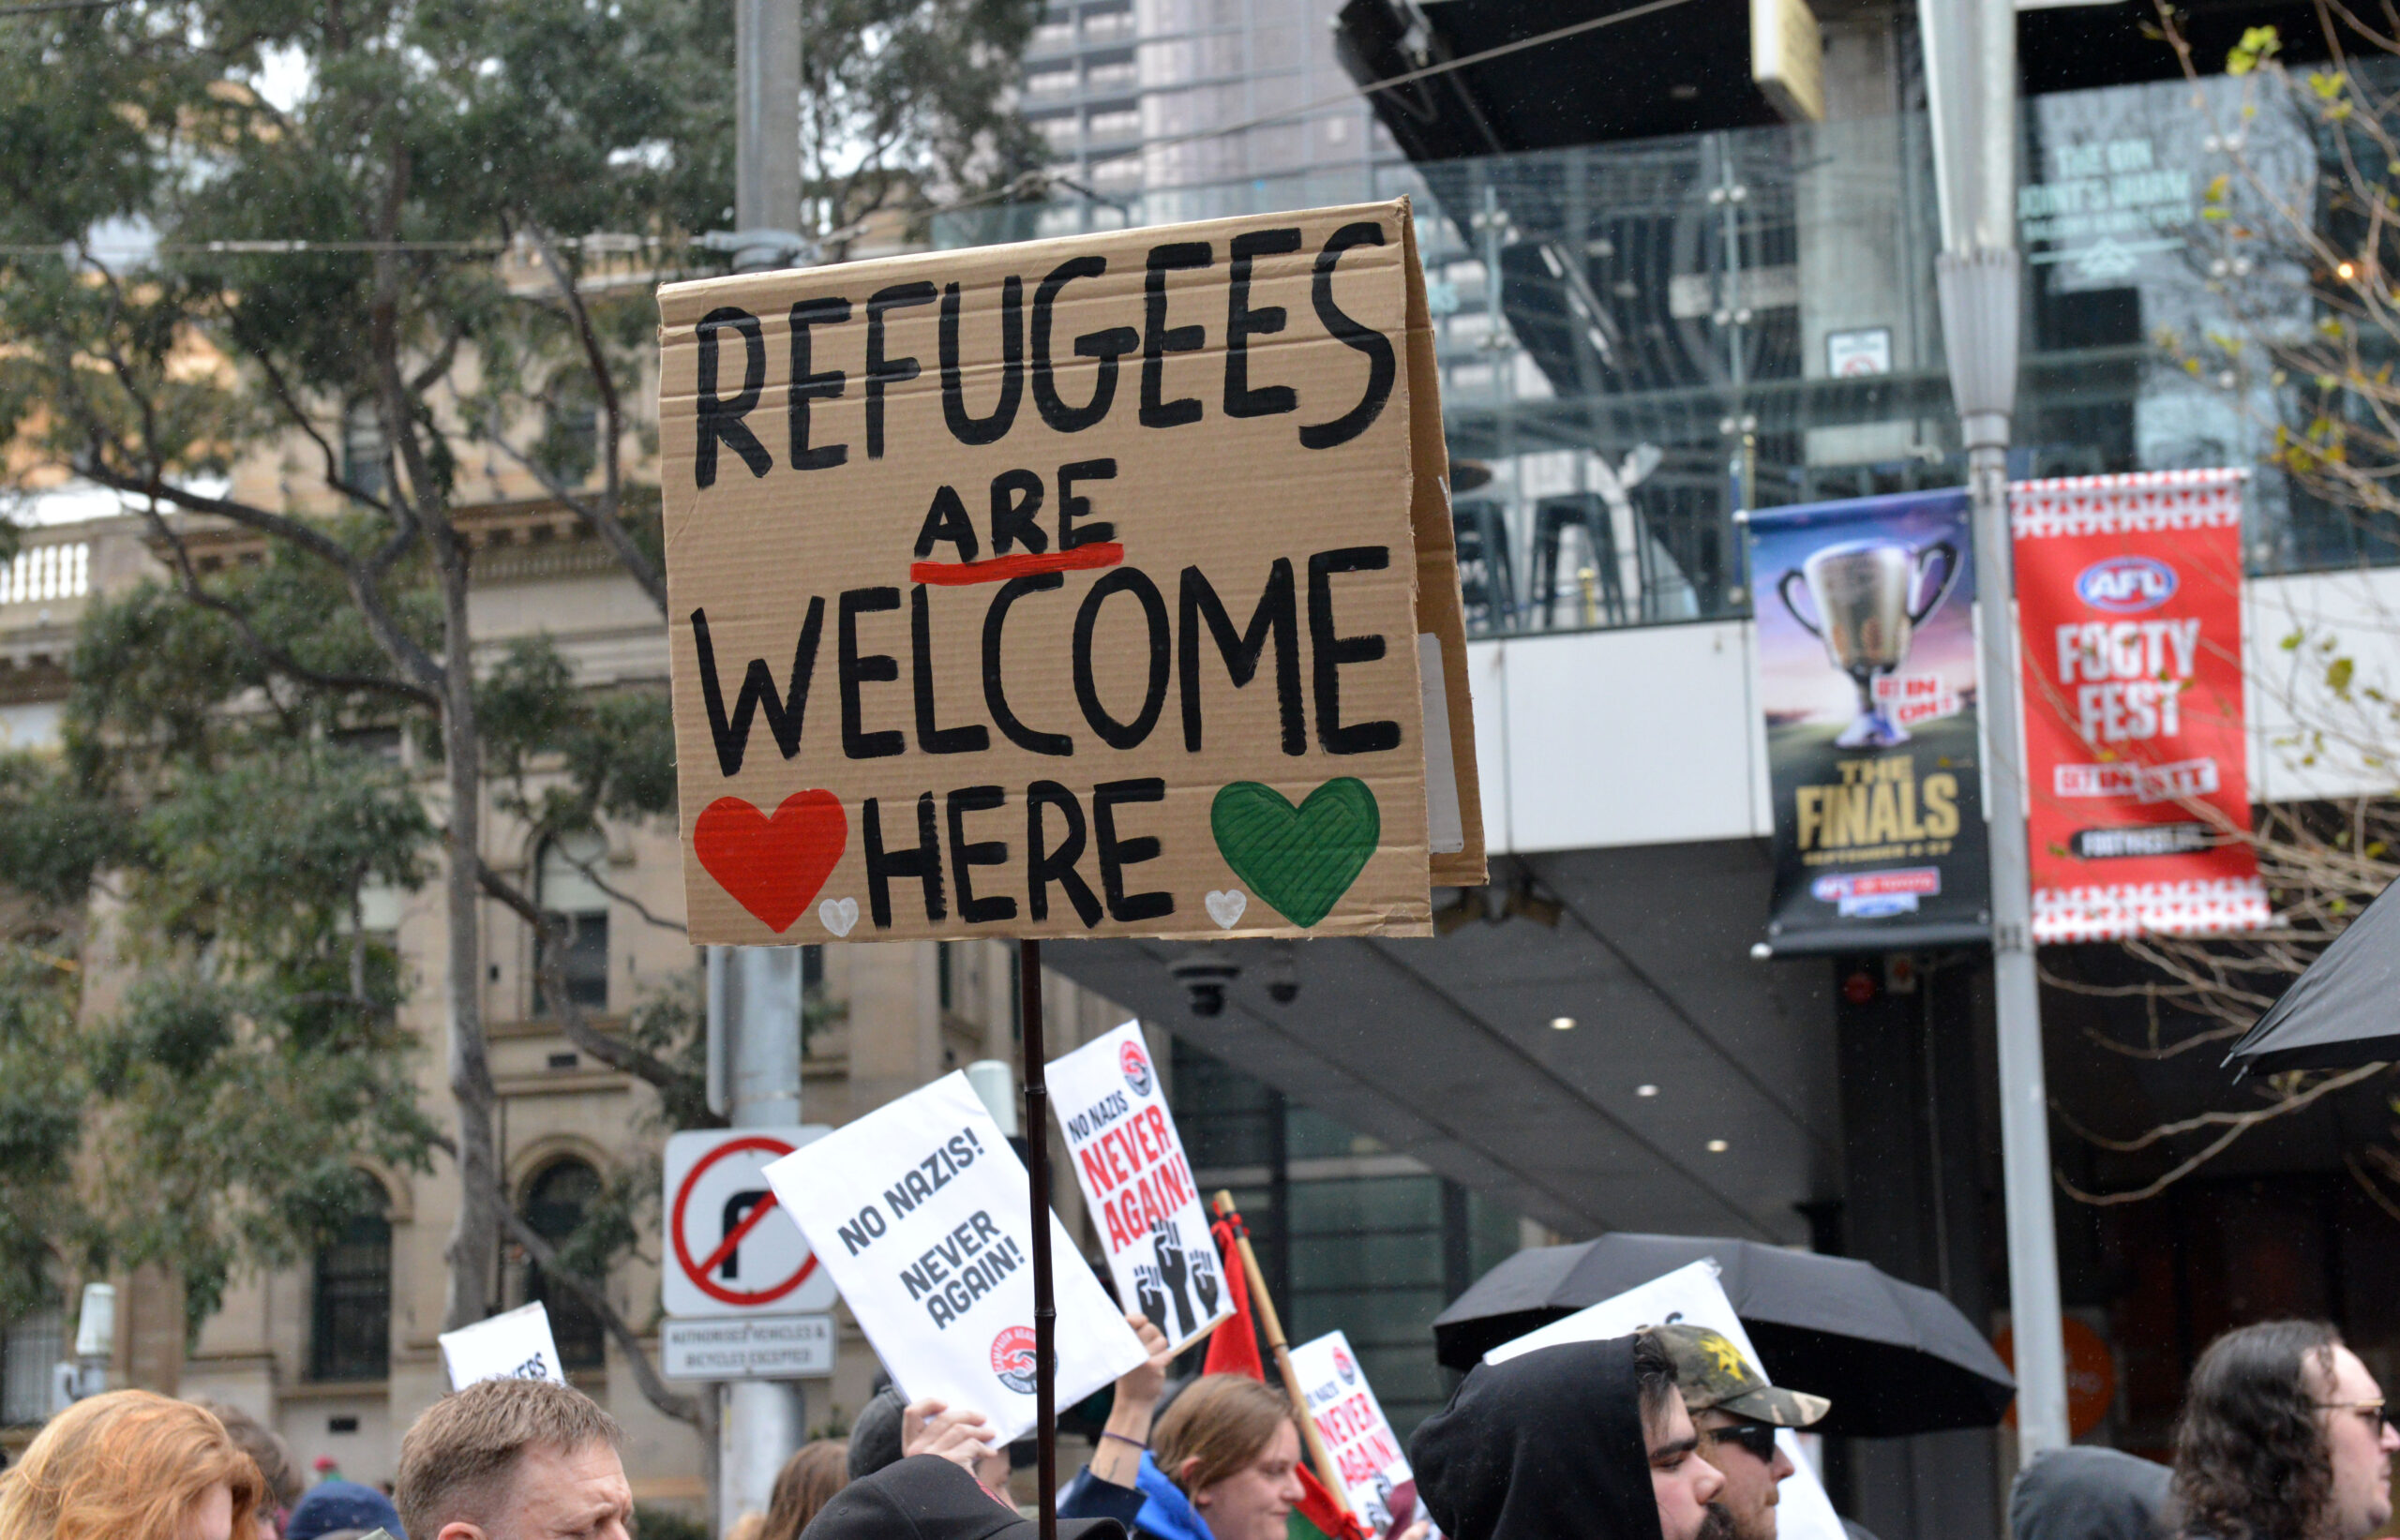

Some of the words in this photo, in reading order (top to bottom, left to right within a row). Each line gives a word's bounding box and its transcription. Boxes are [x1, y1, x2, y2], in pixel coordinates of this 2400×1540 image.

[695, 221, 1396, 490] REFUGEES
[913, 457, 1118, 563] ARE
[2086, 568, 2167, 599] AFL
[690, 546, 1402, 778] WELCOME
[2056, 617, 2200, 684] FOOTY
[2078, 679, 2182, 742] FEST
[1795, 772, 1960, 851] FINALS
[1837, 755, 1914, 785] THE
[862, 776, 1176, 930] HERE
[1068, 1114, 1091, 1144] NO
[1088, 1089, 1129, 1132] NAZIS
[1079, 1104, 1173, 1199] NEVER
[836, 1204, 888, 1257] NO
[883, 1126, 985, 1222] NAZIS!
[1102, 1152, 1195, 1255] AGAIN!
[899, 1209, 1001, 1302] NEVER
[926, 1235, 1026, 1331] AGAIN!
[1313, 1393, 1378, 1452] NEVER
